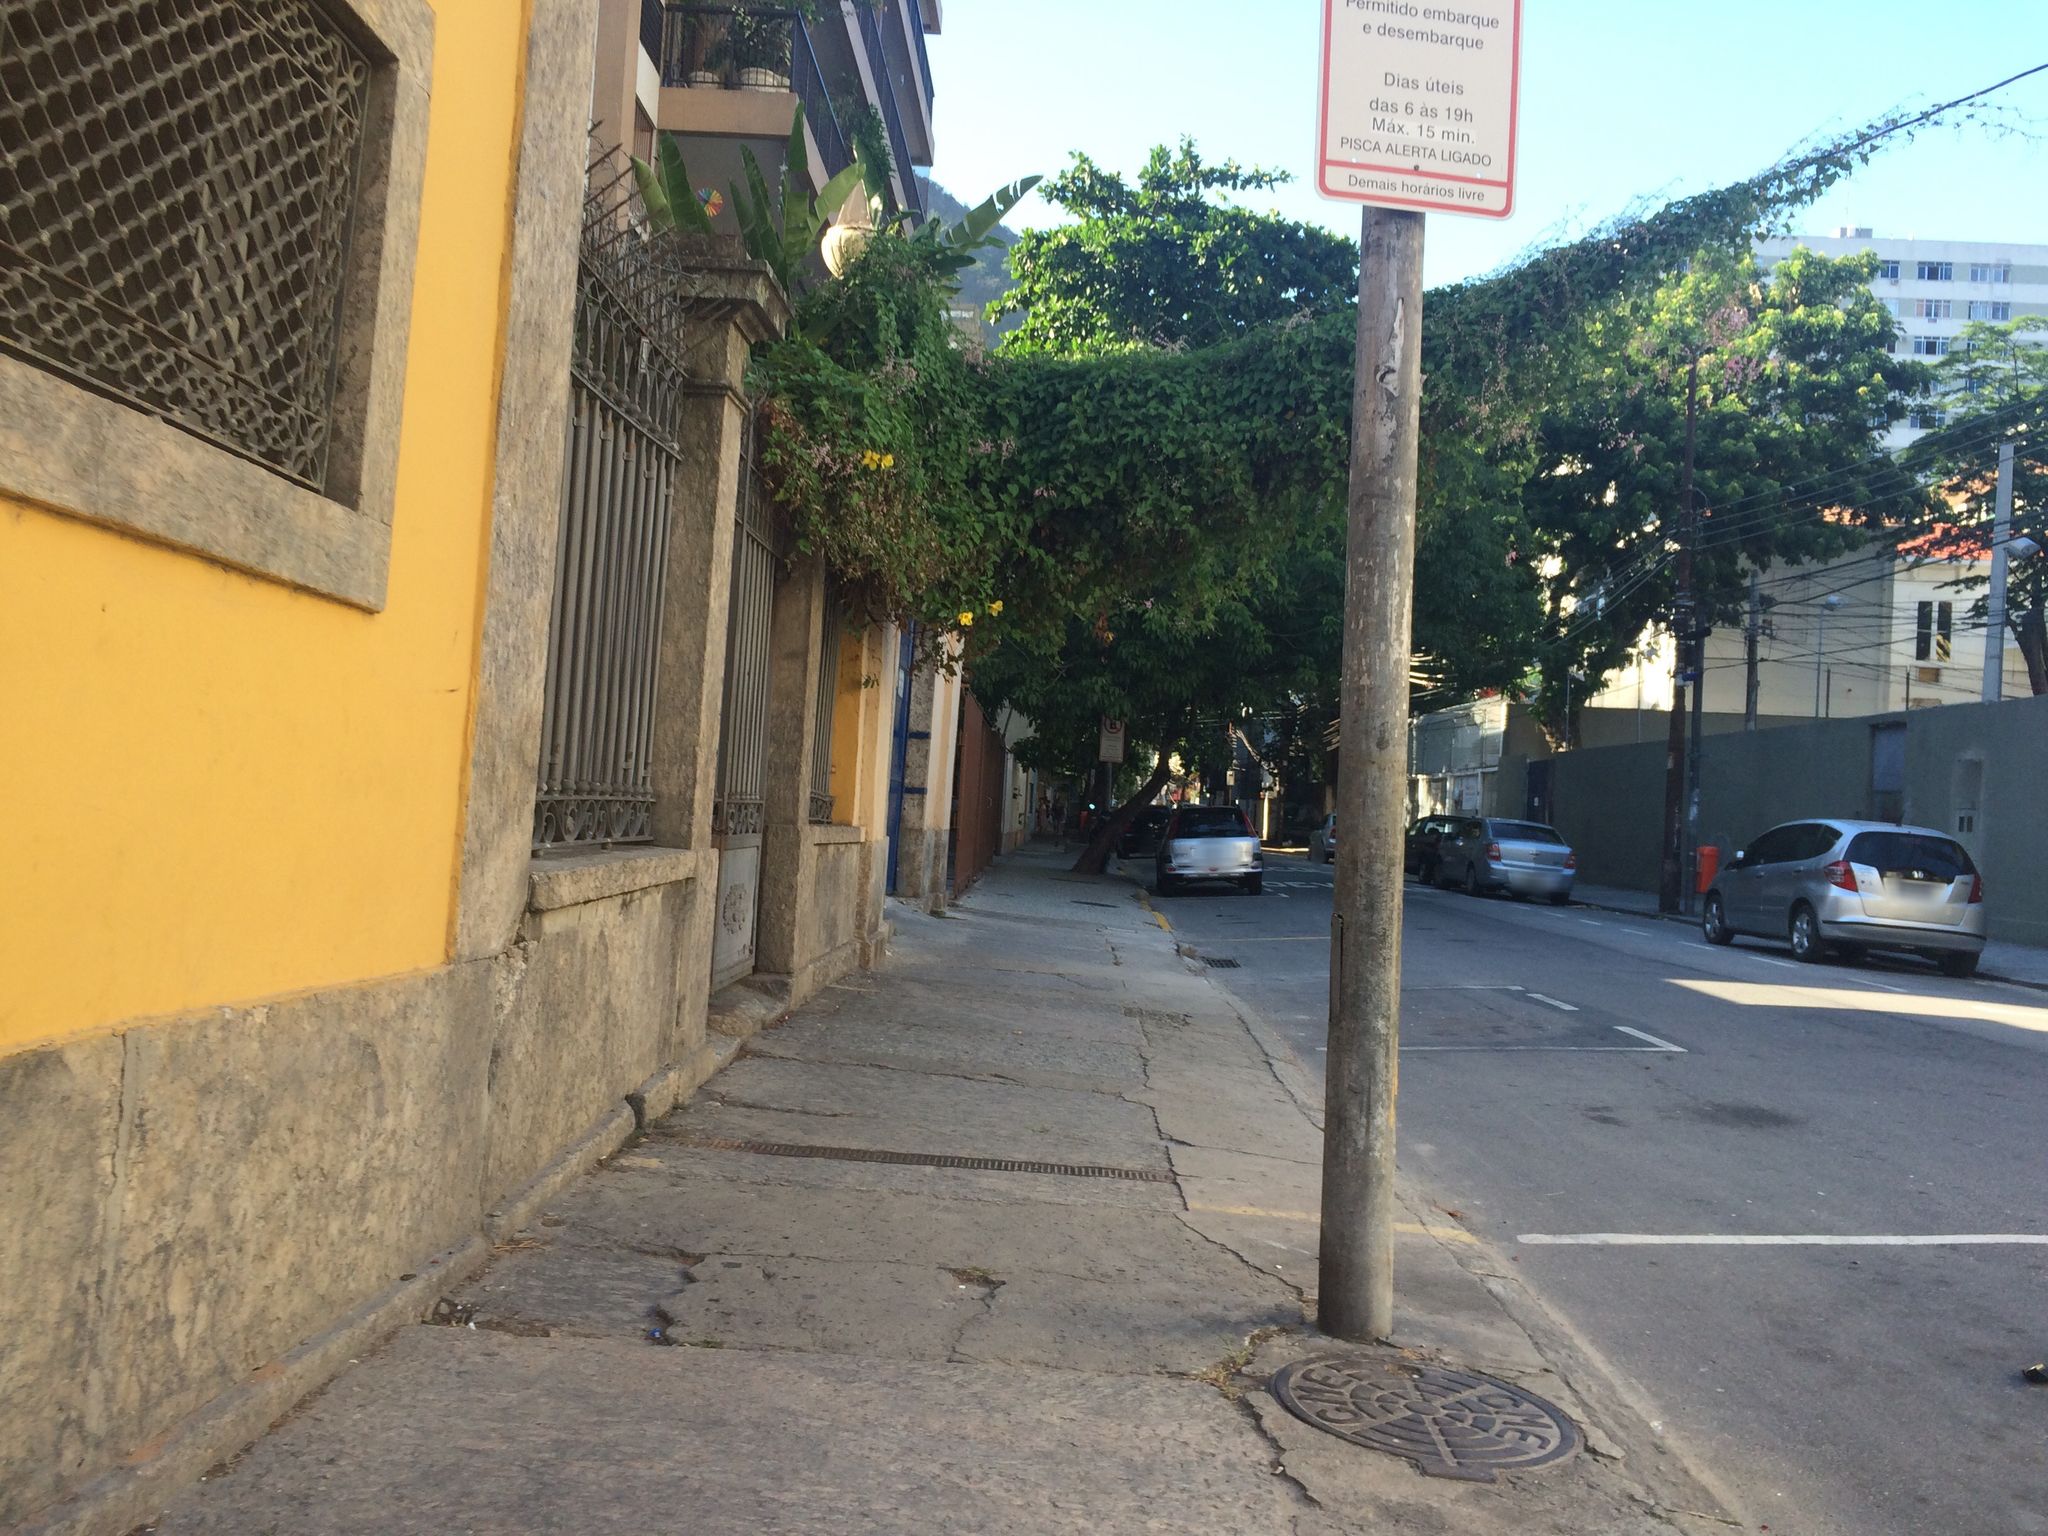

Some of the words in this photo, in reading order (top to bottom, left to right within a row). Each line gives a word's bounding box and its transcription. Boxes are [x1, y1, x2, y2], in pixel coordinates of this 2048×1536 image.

[1423, 7, 1500, 30] embarque
[1362, 22, 1372, 34] e
[1377, 22, 1484, 51] desembarque
[1384, 72, 1419, 90] Dias
[1425, 76, 1464, 95] úteis
[1369, 97, 1399, 113] das
[1404, 102, 1414, 115] 6
[1419, 102, 1438, 119] às
[1446, 106, 1473, 123] 19h
[1372, 117, 1410, 136] Máx.
[1418, 124, 1435, 139] 15
[1441, 129, 1475, 144] min.
[1340, 136, 1381, 153] PISCA
[1385, 143, 1437, 160] ALERTA
[1441, 149, 1492, 167] LIGADO
[1348, 174, 1397, 191] Demais
[1401, 181, 1454, 199] horários
[1458, 188, 1485, 201] livre
